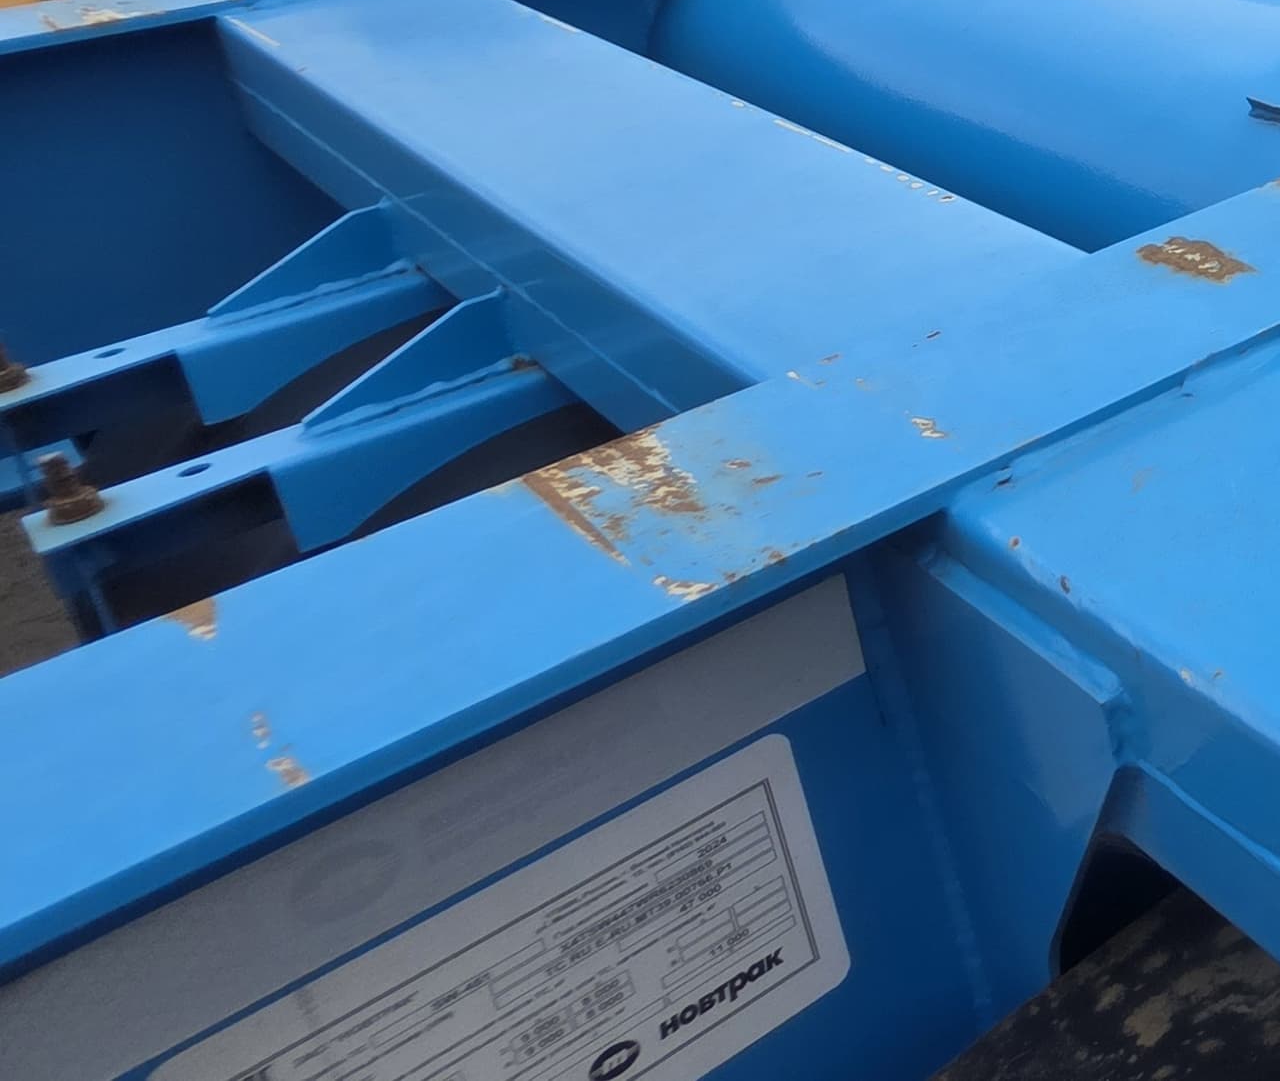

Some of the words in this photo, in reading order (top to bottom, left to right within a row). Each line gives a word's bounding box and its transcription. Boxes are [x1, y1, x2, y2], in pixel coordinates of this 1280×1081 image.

[697, 836, 727, 859] 2024
[698, 883, 722, 901] 000
[728, 927, 750, 945] 000
